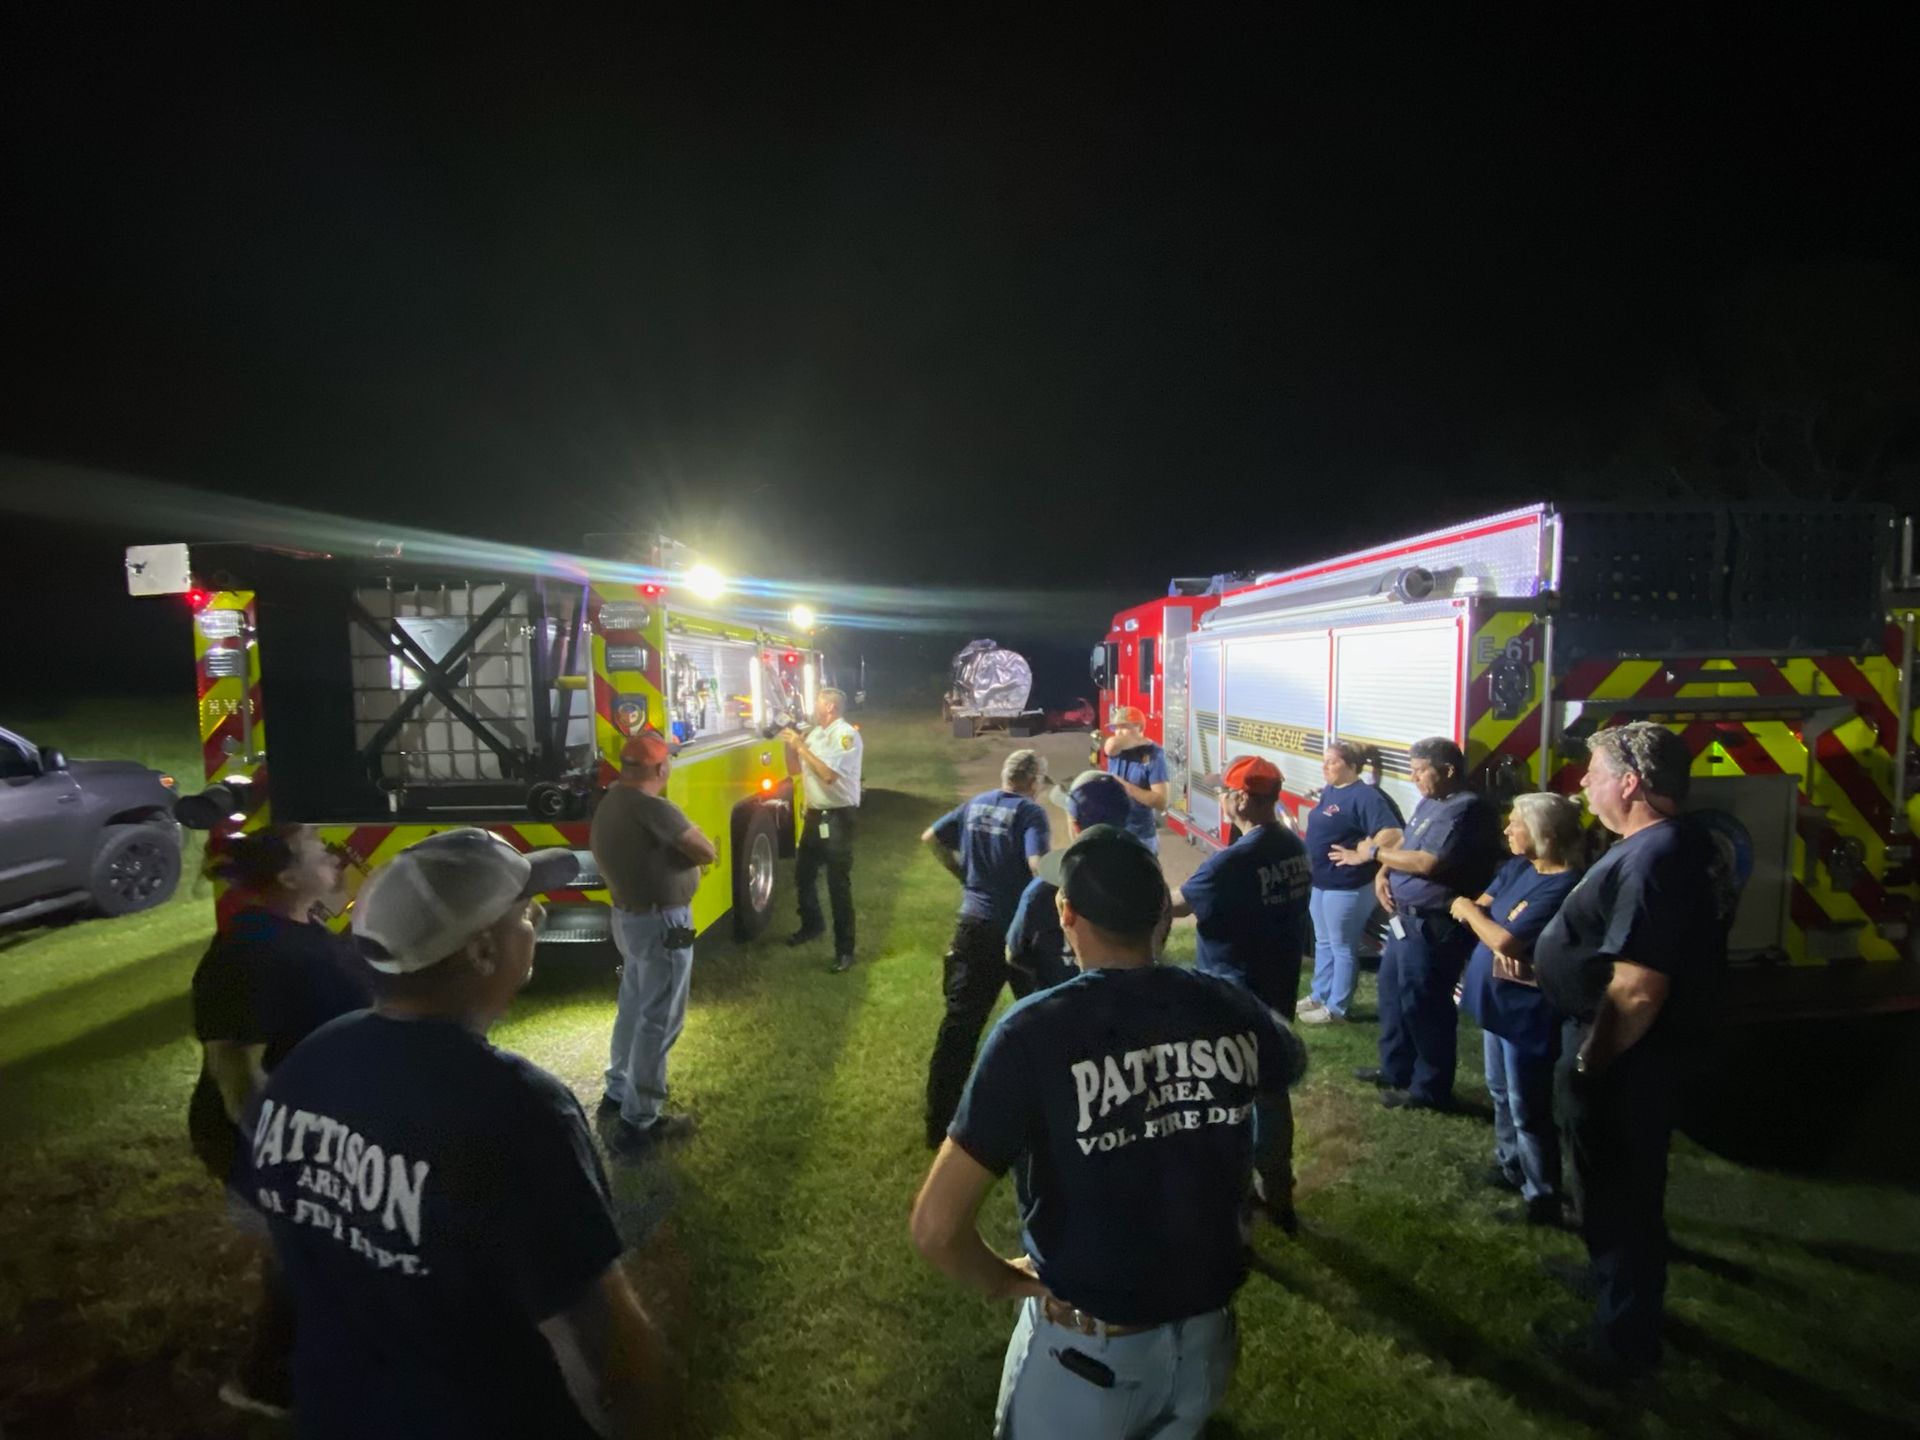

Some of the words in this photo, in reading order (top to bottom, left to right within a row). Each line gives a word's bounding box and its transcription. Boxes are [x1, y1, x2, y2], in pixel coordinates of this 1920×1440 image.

[1477, 636, 1535, 664] E-61
[1239, 722, 1260, 741] FIRE
[1262, 726, 1305, 752] RESCUE
[1071, 1031, 1259, 1132] PATTISON
[1145, 1080, 1214, 1112] AREA
[1076, 1127, 1137, 1156] VOL.
[1143, 1110, 1201, 1138] FIRE
